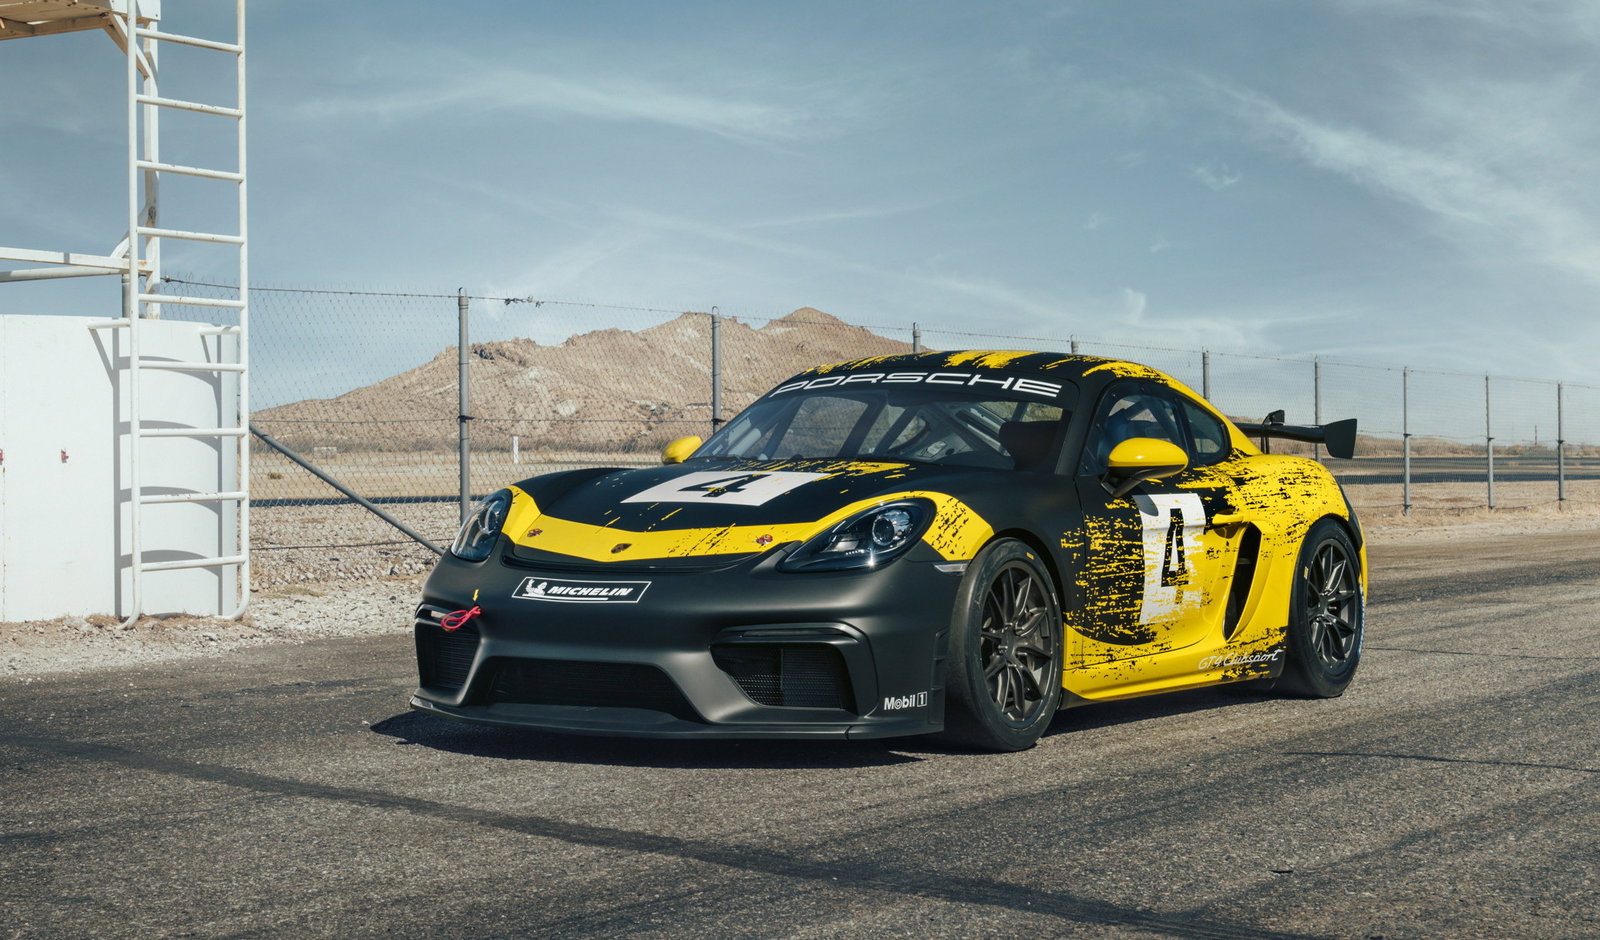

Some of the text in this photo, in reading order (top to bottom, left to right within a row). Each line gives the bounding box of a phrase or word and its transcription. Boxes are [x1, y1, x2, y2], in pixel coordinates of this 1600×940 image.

[769, 373, 1062, 398] PORSCHE
[677, 474, 772, 497] 4
[1161, 508, 1189, 605] 4
[547, 586, 634, 596] MICHELIN
[1223, 649, 1284, 667] Clubsport
[884, 694, 915, 710] Mobil
